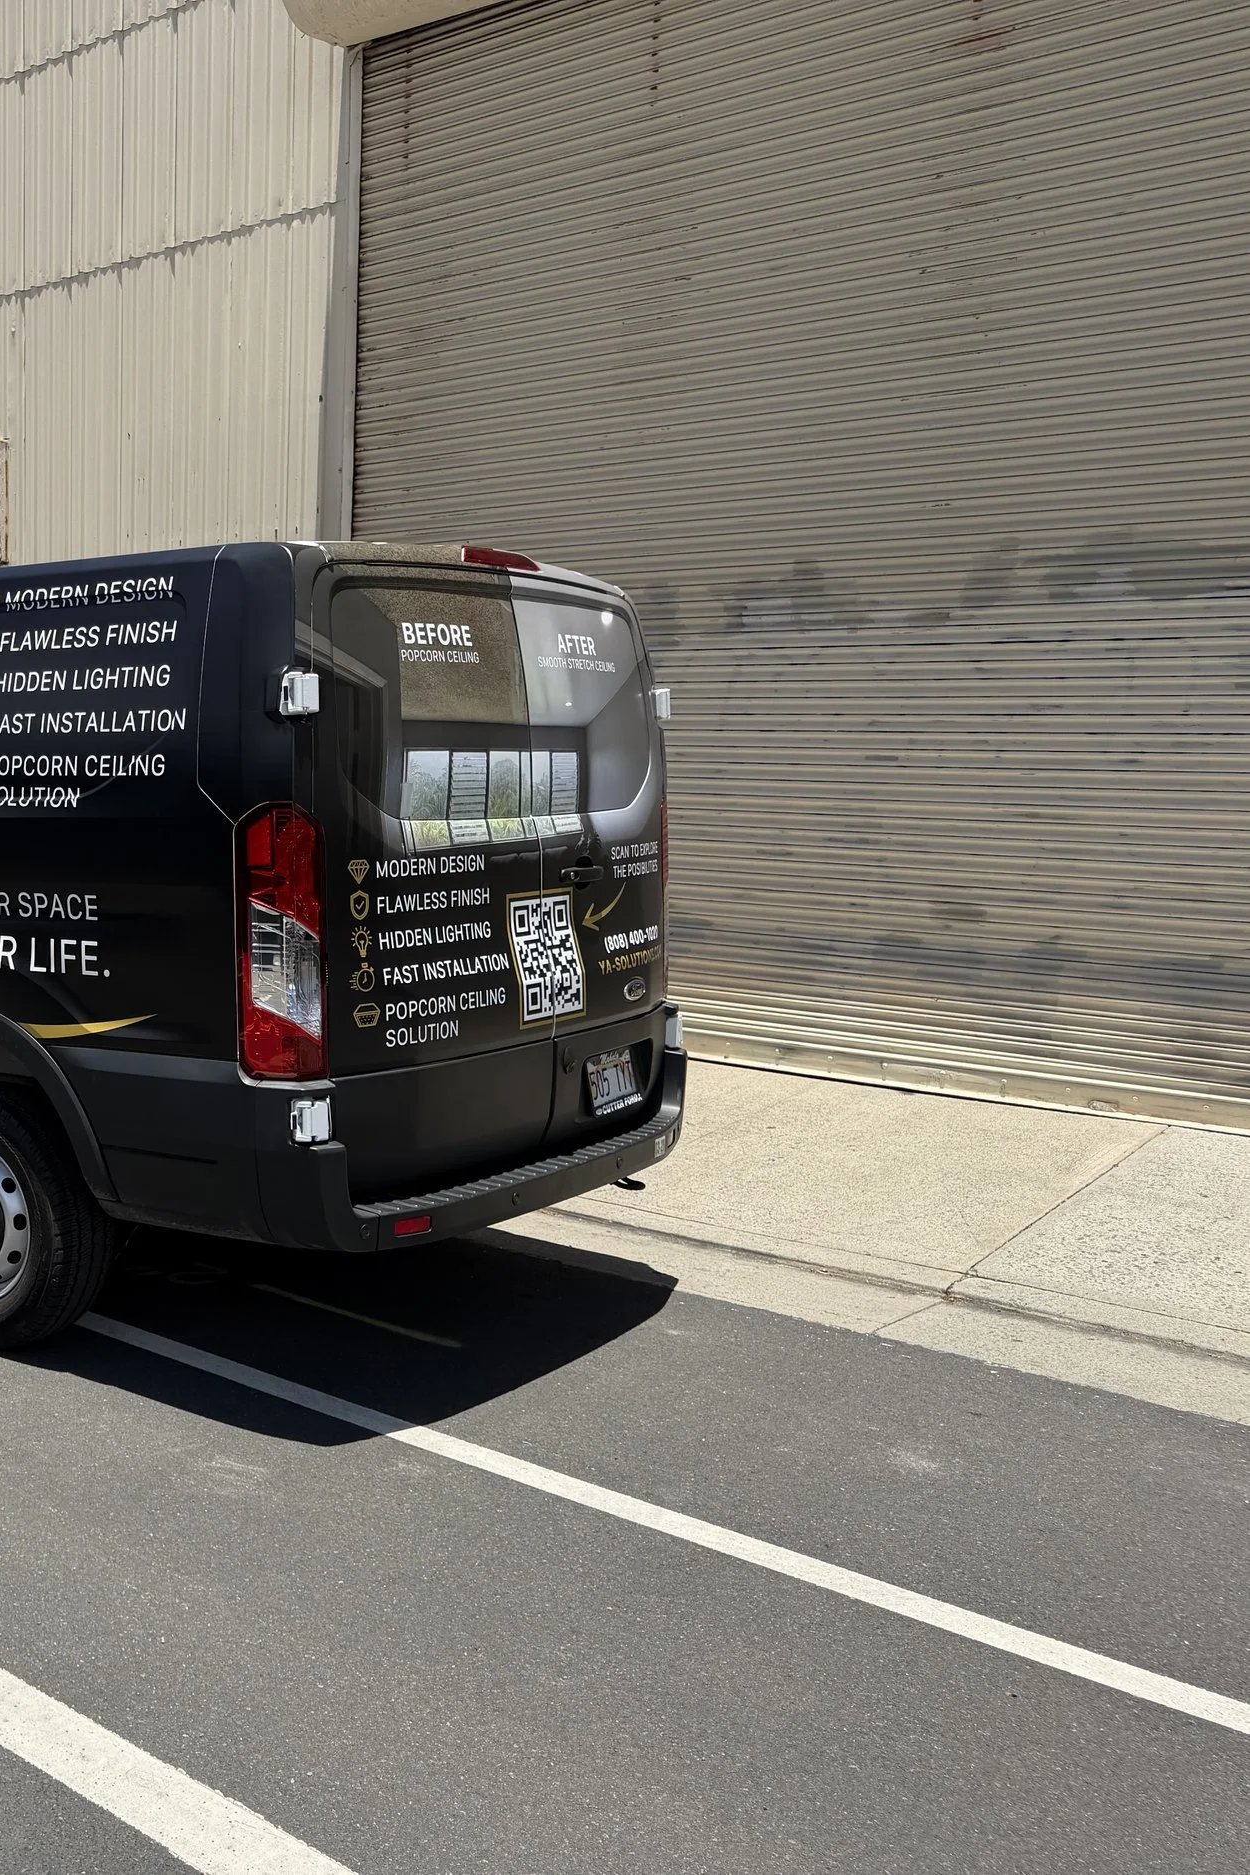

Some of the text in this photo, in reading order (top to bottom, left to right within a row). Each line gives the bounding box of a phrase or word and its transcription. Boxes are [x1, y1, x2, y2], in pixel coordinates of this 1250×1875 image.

[5, 576, 174, 612] MODERN DESIGN
[0, 620, 178, 652] FLAWLESS FINISH
[401, 622, 473, 647] BEFORE
[557, 633, 597, 656] AFTER
[401, 650, 480, 664] POPCORN CEILING
[537, 655, 616, 673] SMOOTH STRETCH CEILING
[72, 664, 171, 691] LIGHTING
[40, 708, 187, 734] INSTALLATION
[84, 753, 166, 778] CEILING
[610, 841, 659, 860] SCAN TO EXPLORE
[376, 854, 485, 879] MODERN DESIGN
[613, 864, 627, 879] THE
[17, 892, 99, 921] SPACE
[377, 888, 490, 914] FLAWLESS FINISH
[379, 921, 492, 950] HIDDEN LIGHTING
[604, 932, 629, 954] (808)
[29, 937, 111, 978] LIFE.
[383, 953, 510, 986] FAST INSTALLATION
[385, 987, 506, 1021] POPCORN CEILING
[386, 1020, 459, 1047] SOLUTION
[589, 1068, 610, 1101] 505
[602, 1099, 625, 1115] CUTTER
